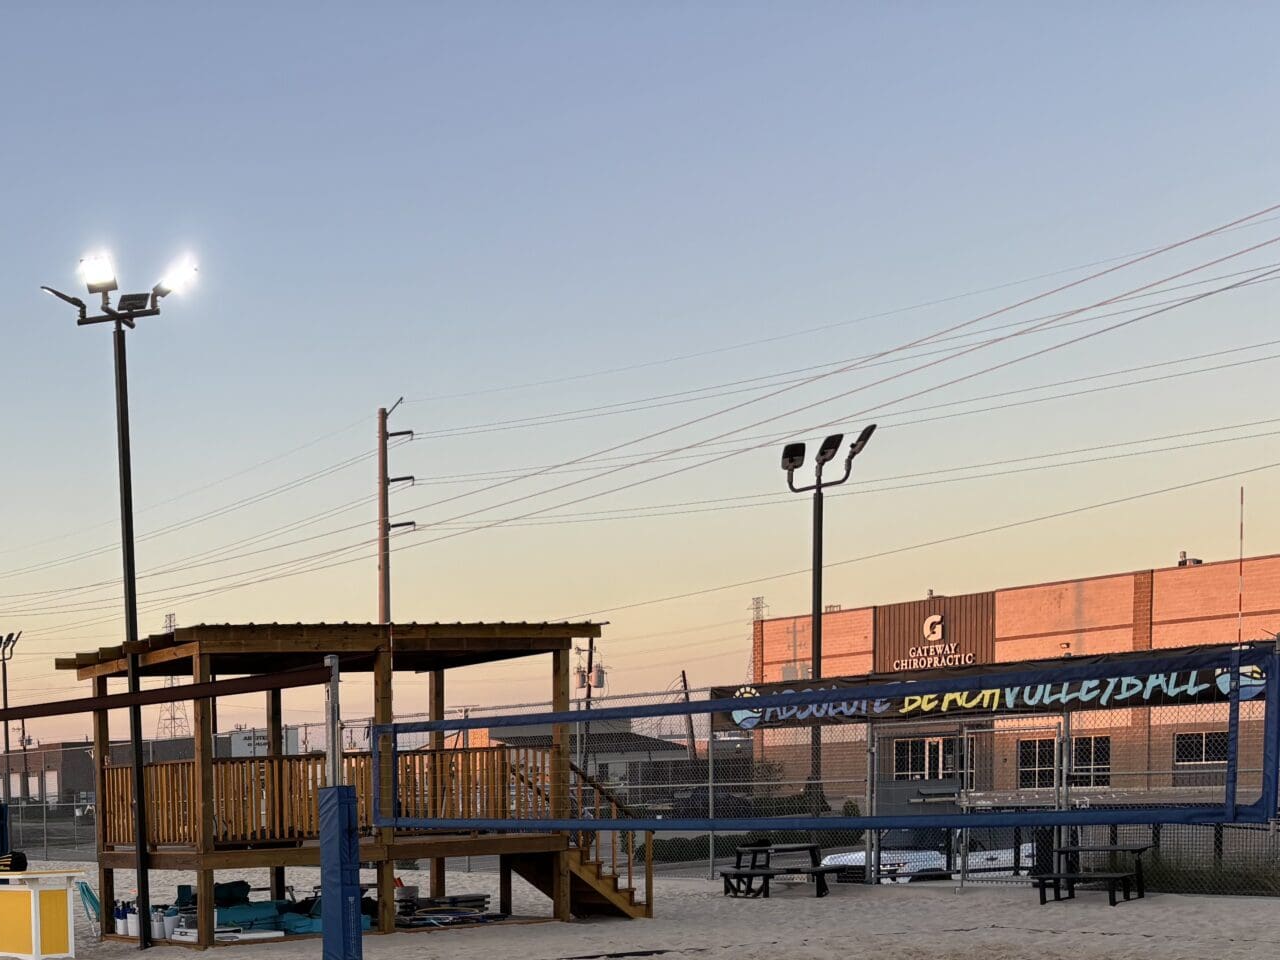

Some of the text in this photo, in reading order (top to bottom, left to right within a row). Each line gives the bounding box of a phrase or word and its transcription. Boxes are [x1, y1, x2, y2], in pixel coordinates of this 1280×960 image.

[923, 615, 943, 641] G
[909, 643, 958, 658] GATEWAY
[893, 653, 974, 670] CHIROPRACTIC
